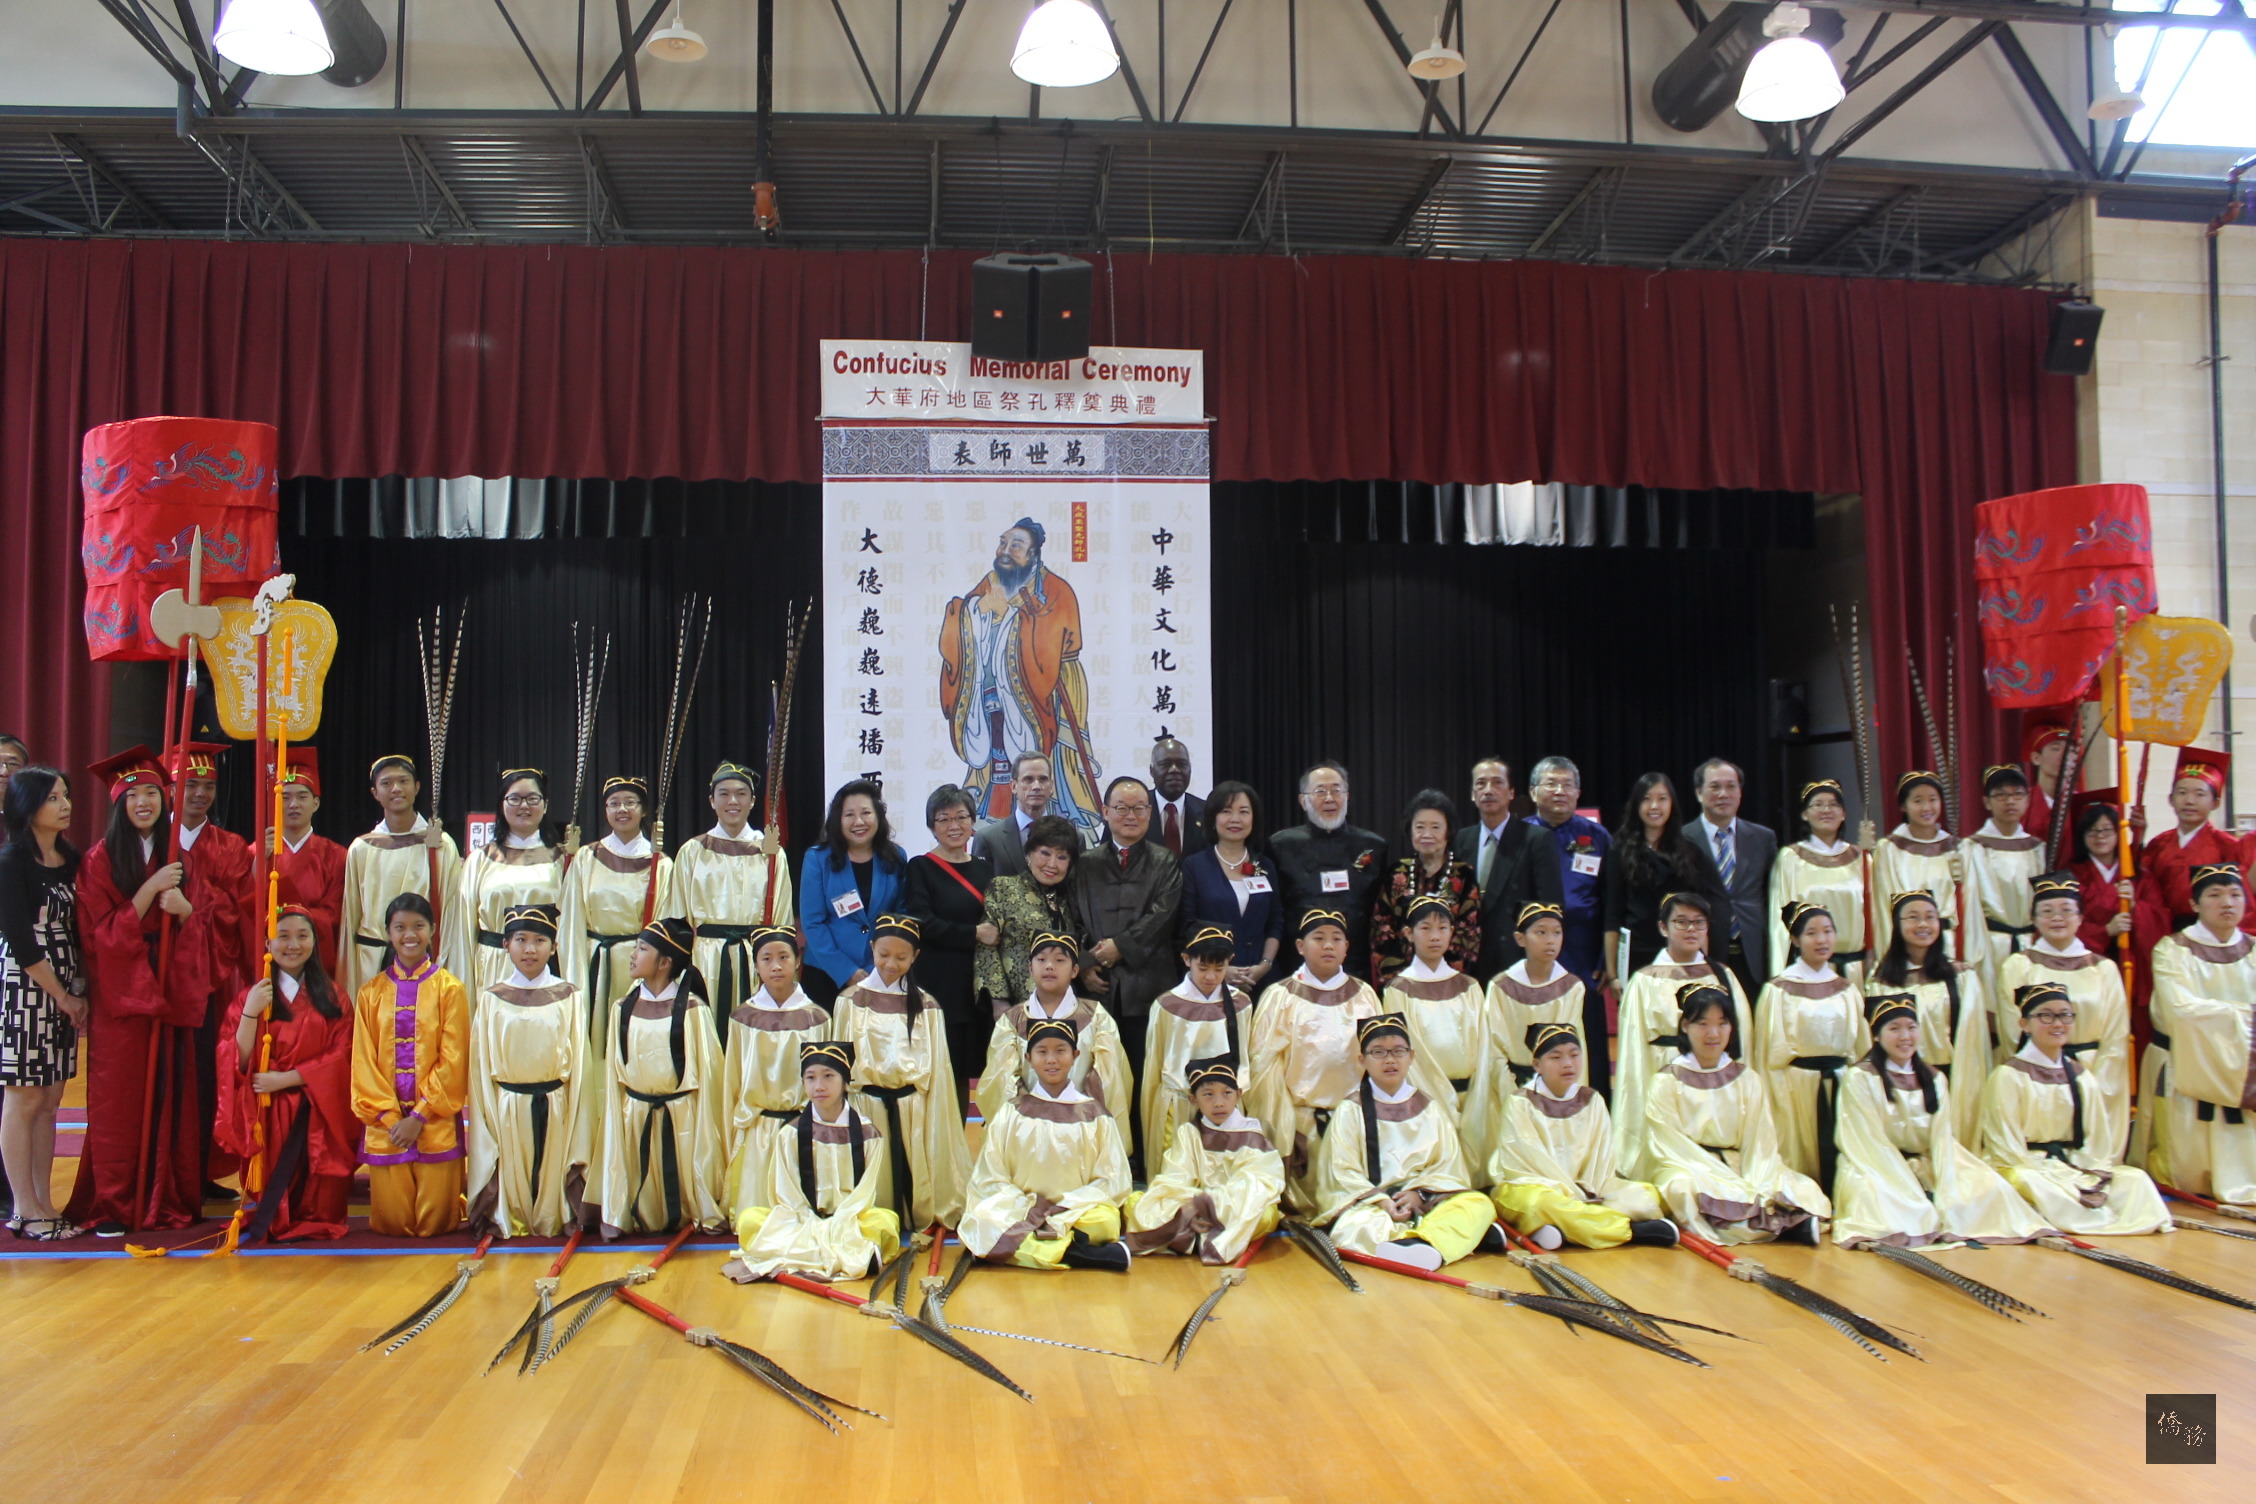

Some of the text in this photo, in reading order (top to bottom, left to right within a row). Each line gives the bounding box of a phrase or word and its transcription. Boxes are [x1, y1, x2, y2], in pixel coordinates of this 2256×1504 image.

[833, 350, 1191, 388] Confucius Memorial Ceremony
[866, 386, 1156, 415] 大華府地區祭孔釋奠典禮
